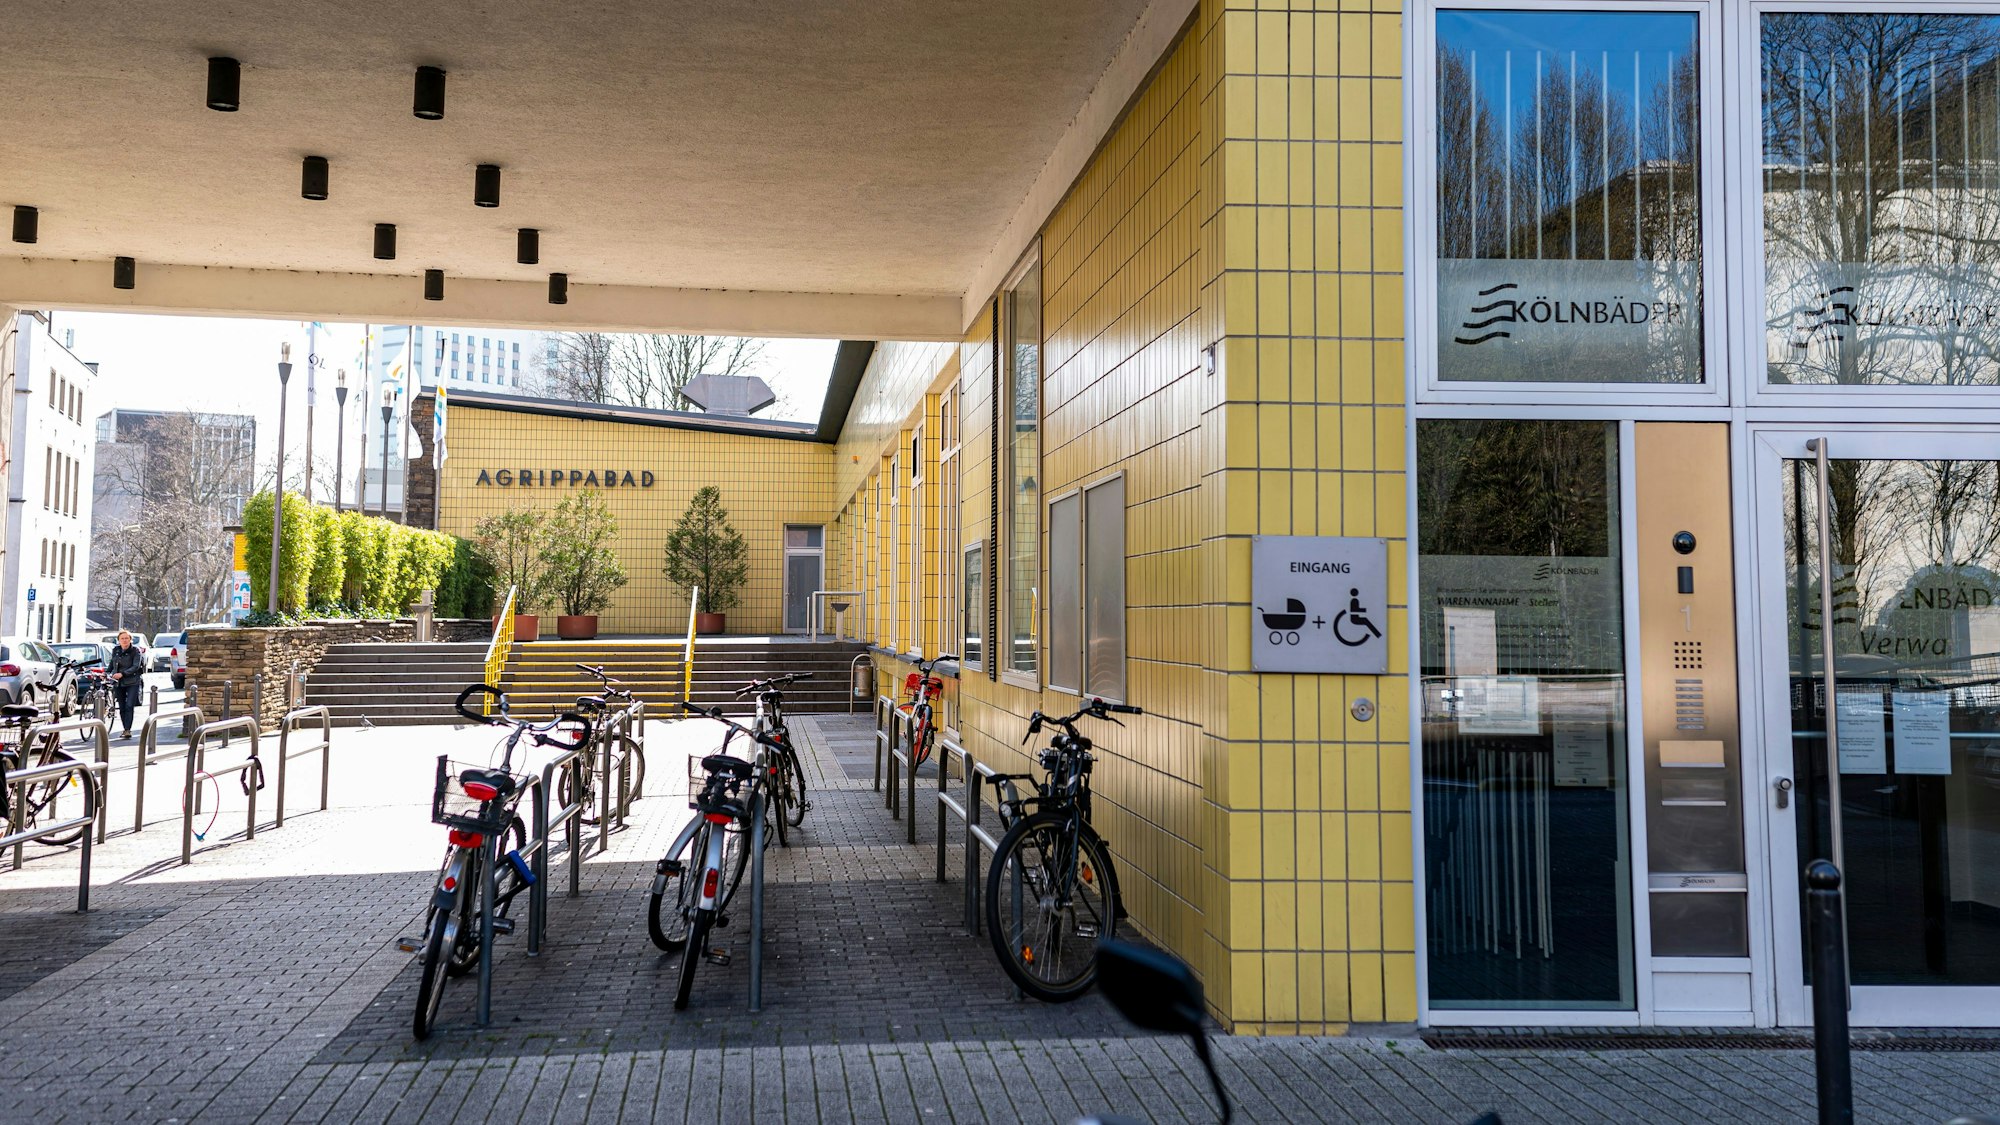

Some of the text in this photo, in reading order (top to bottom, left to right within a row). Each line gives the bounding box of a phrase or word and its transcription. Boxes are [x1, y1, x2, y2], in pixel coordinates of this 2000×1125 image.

[1512, 295, 1683, 324] KÖLNBÄDER
[475, 469, 655, 488] AGRIPPABAD
[1290, 561, 1351, 574] EINGANG
